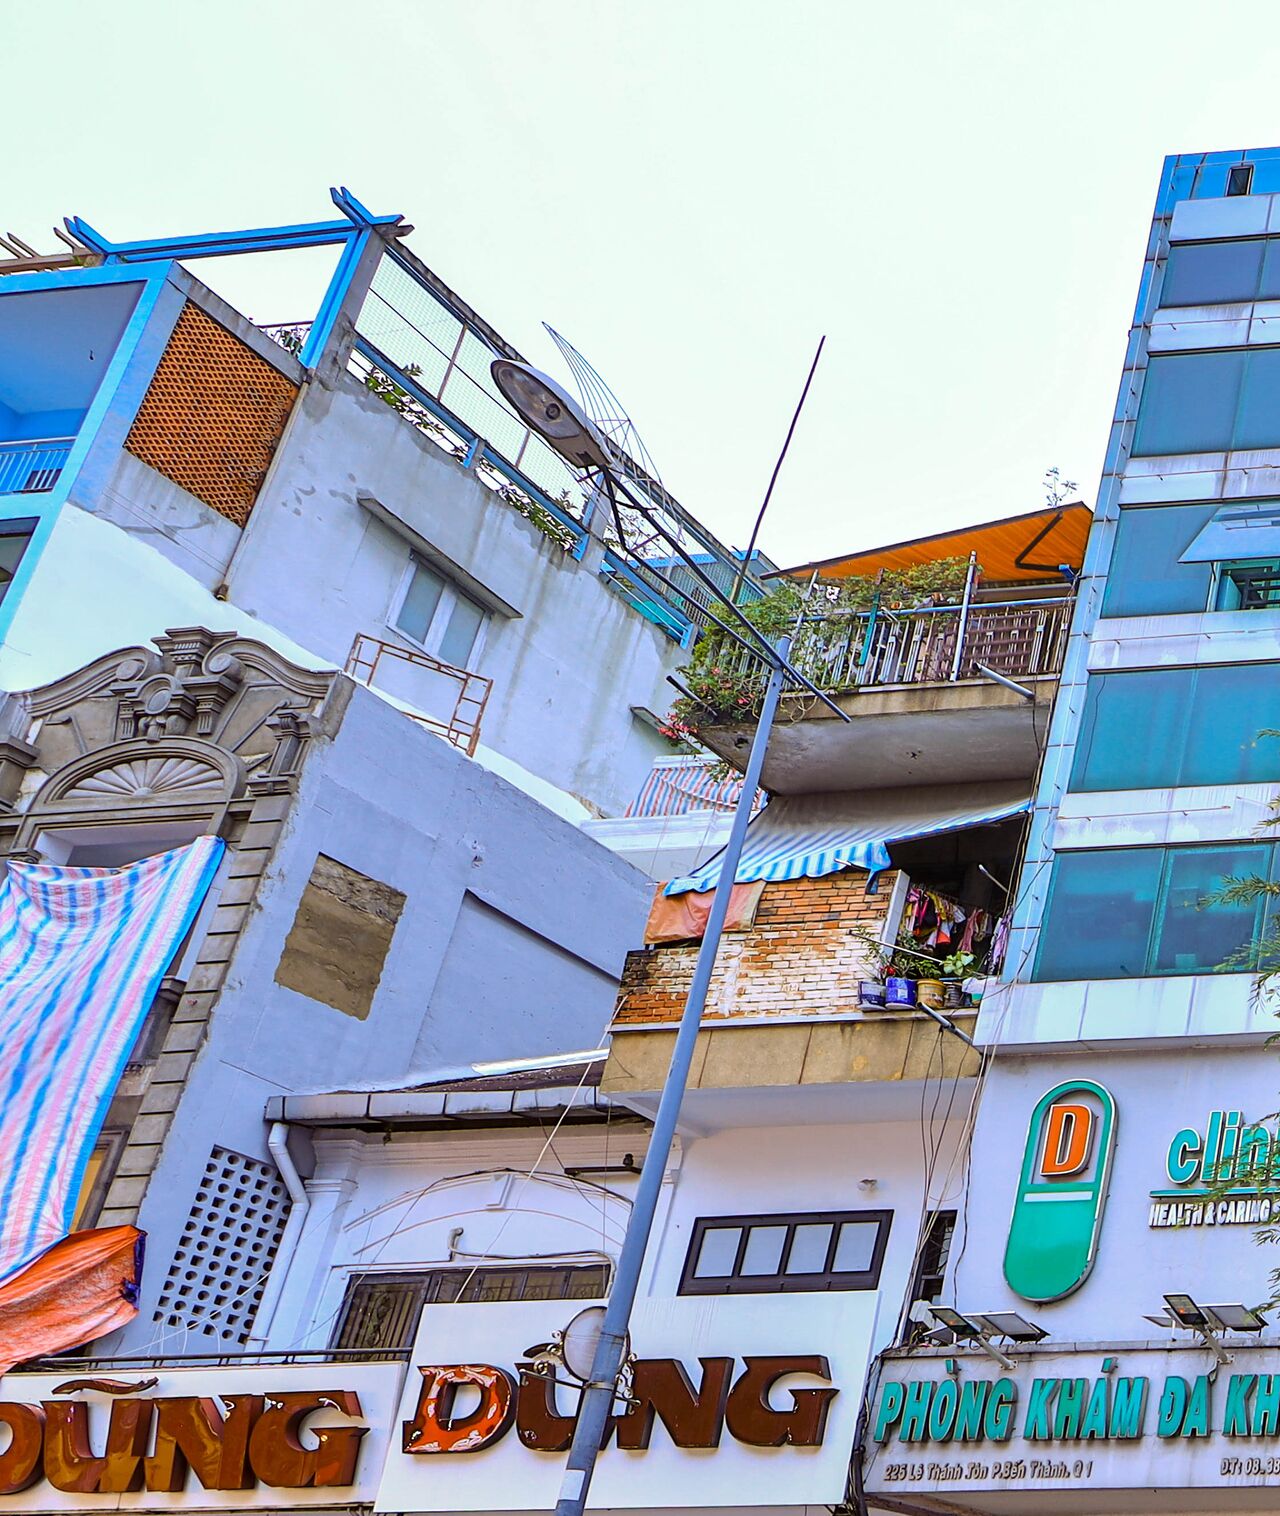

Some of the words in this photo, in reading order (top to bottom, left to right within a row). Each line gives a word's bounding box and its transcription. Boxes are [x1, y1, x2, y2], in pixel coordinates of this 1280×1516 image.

[1040, 1103, 1095, 1176] D
[1149, 1202, 1203, 1228] HEALTH
[1204, 1202, 1217, 1225] &
[1217, 1198, 1271, 1224] CARING
[873, 1359, 1017, 1442] PHÒNG
[1023, 1356, 1149, 1440] KHÁM
[1157, 1373, 1214, 1438] ĐA
[883, 1463, 907, 1481] 225
[908, 1463, 924, 1480] Lê
[927, 1461, 963, 1480] Thánh
[1073, 1460, 1083, 1478] Q
[1085, 1460, 1094, 1478] 1
